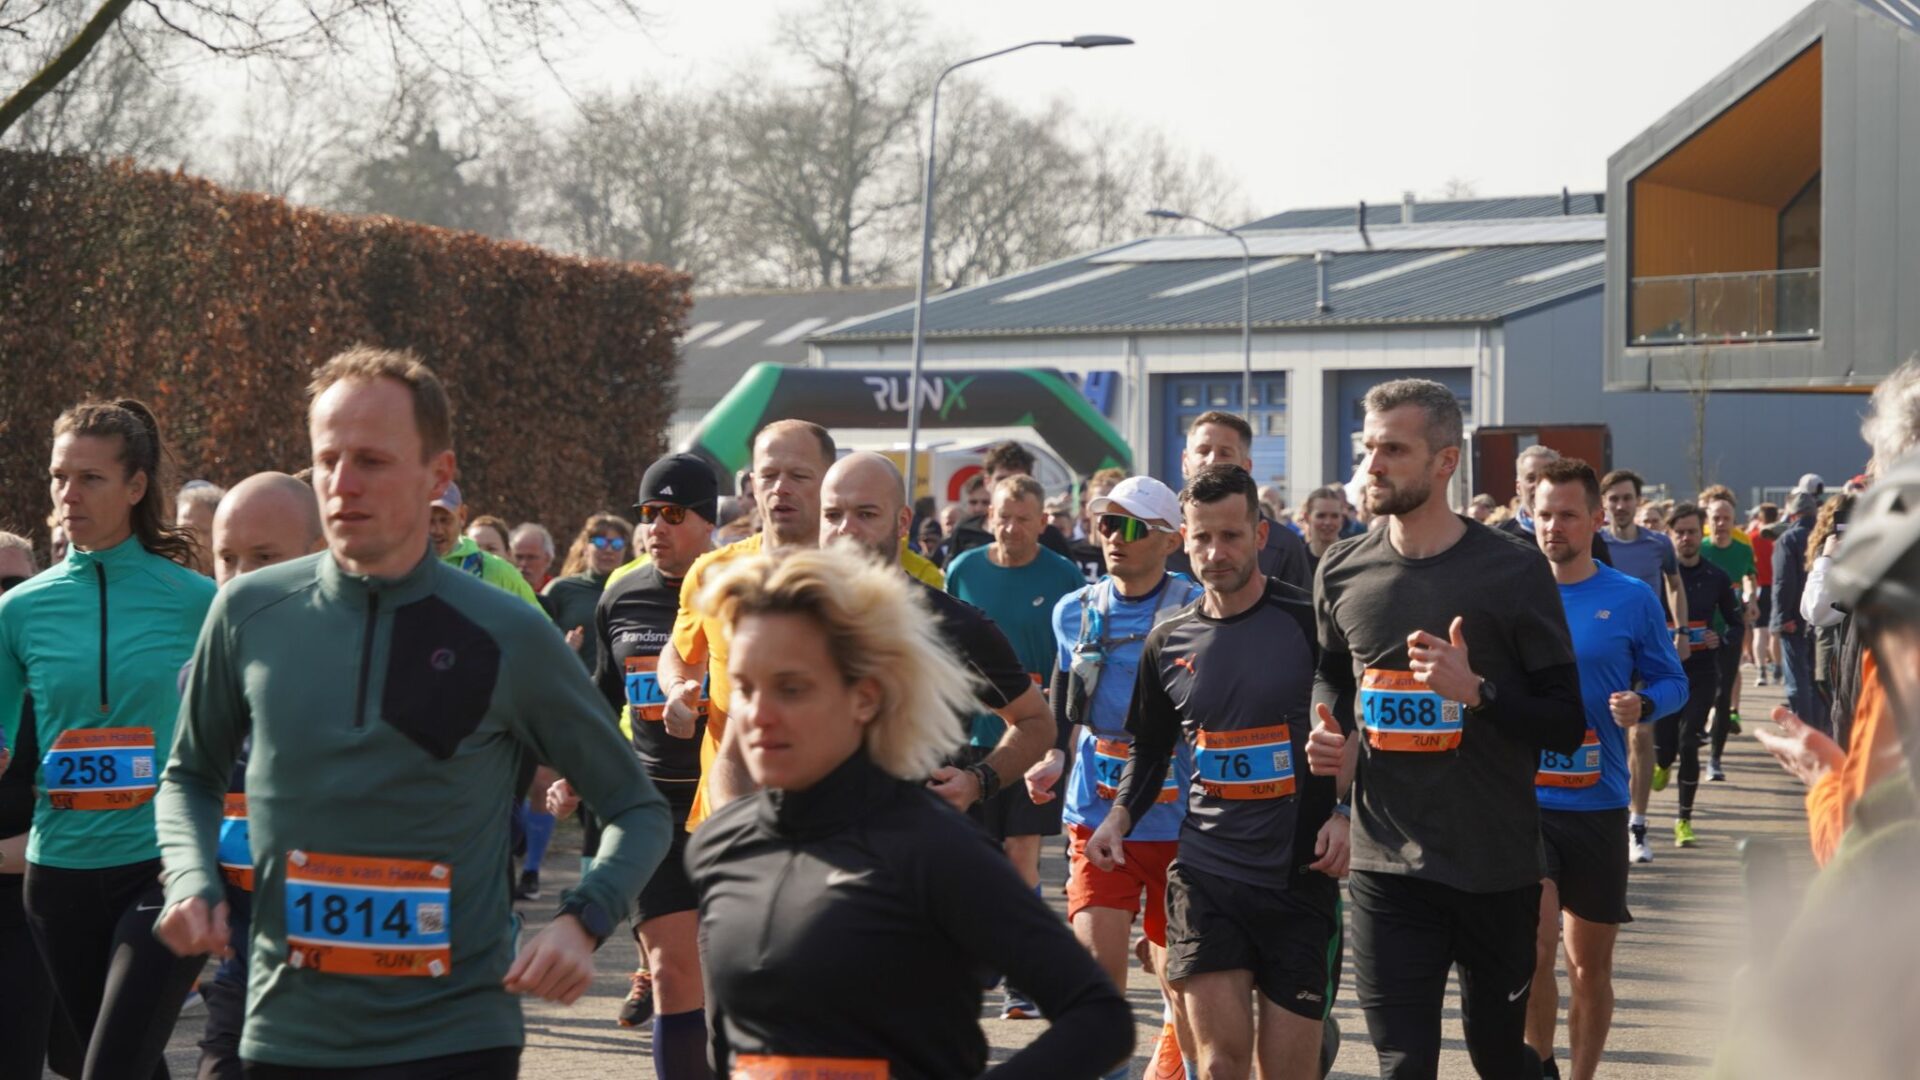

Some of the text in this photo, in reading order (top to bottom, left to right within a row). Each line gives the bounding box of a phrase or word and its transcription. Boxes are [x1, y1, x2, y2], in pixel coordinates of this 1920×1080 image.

[863, 375, 979, 421] RUNX
[1365, 696, 1437, 726] 1568
[58, 755, 117, 785] 258
[1214, 753, 1251, 778] 76
[295, 892, 411, 939] 1814
